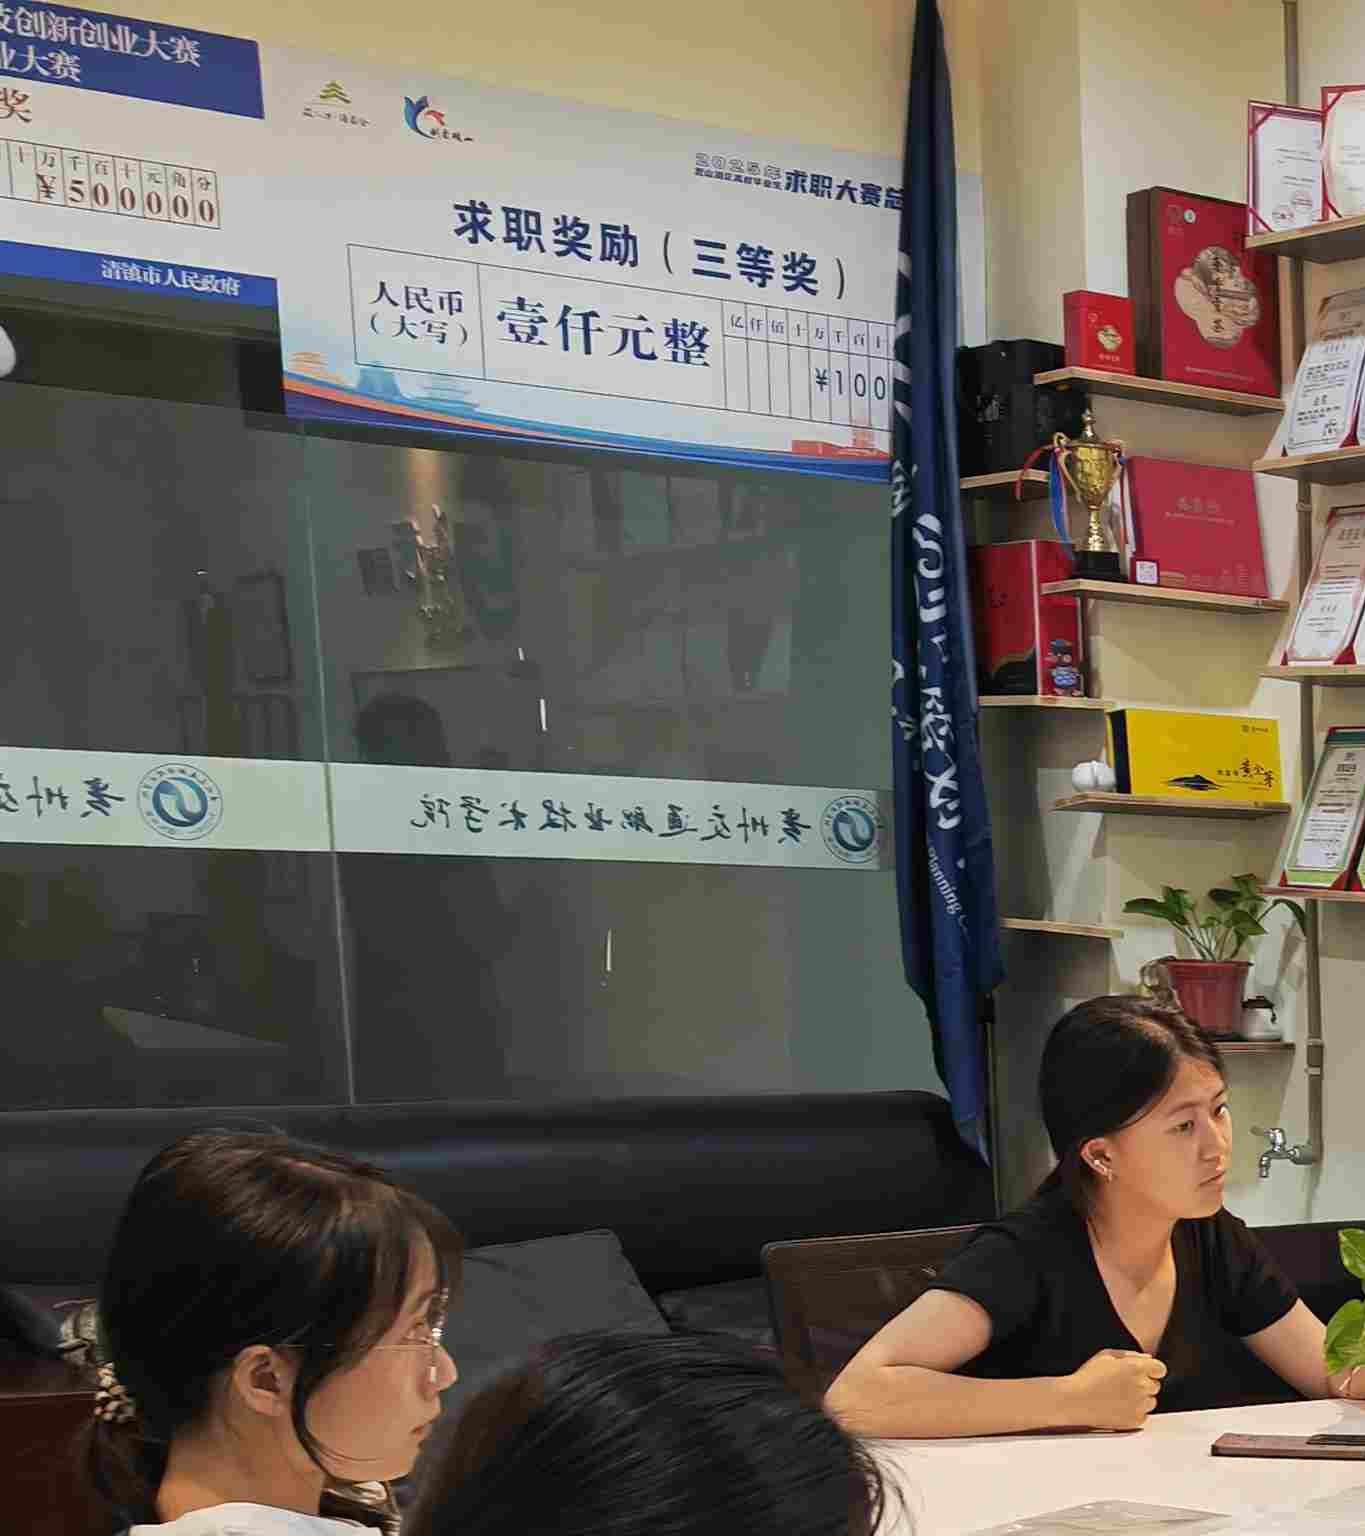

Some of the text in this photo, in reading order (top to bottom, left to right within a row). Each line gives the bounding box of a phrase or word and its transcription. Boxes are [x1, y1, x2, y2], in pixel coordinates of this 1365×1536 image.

[100, 258, 241, 297] 清镇市人民政府
[369, 280, 465, 316] 人民币
[370, 312, 468, 346] （大写）
[496, 296, 712, 368] 壹仟元整
